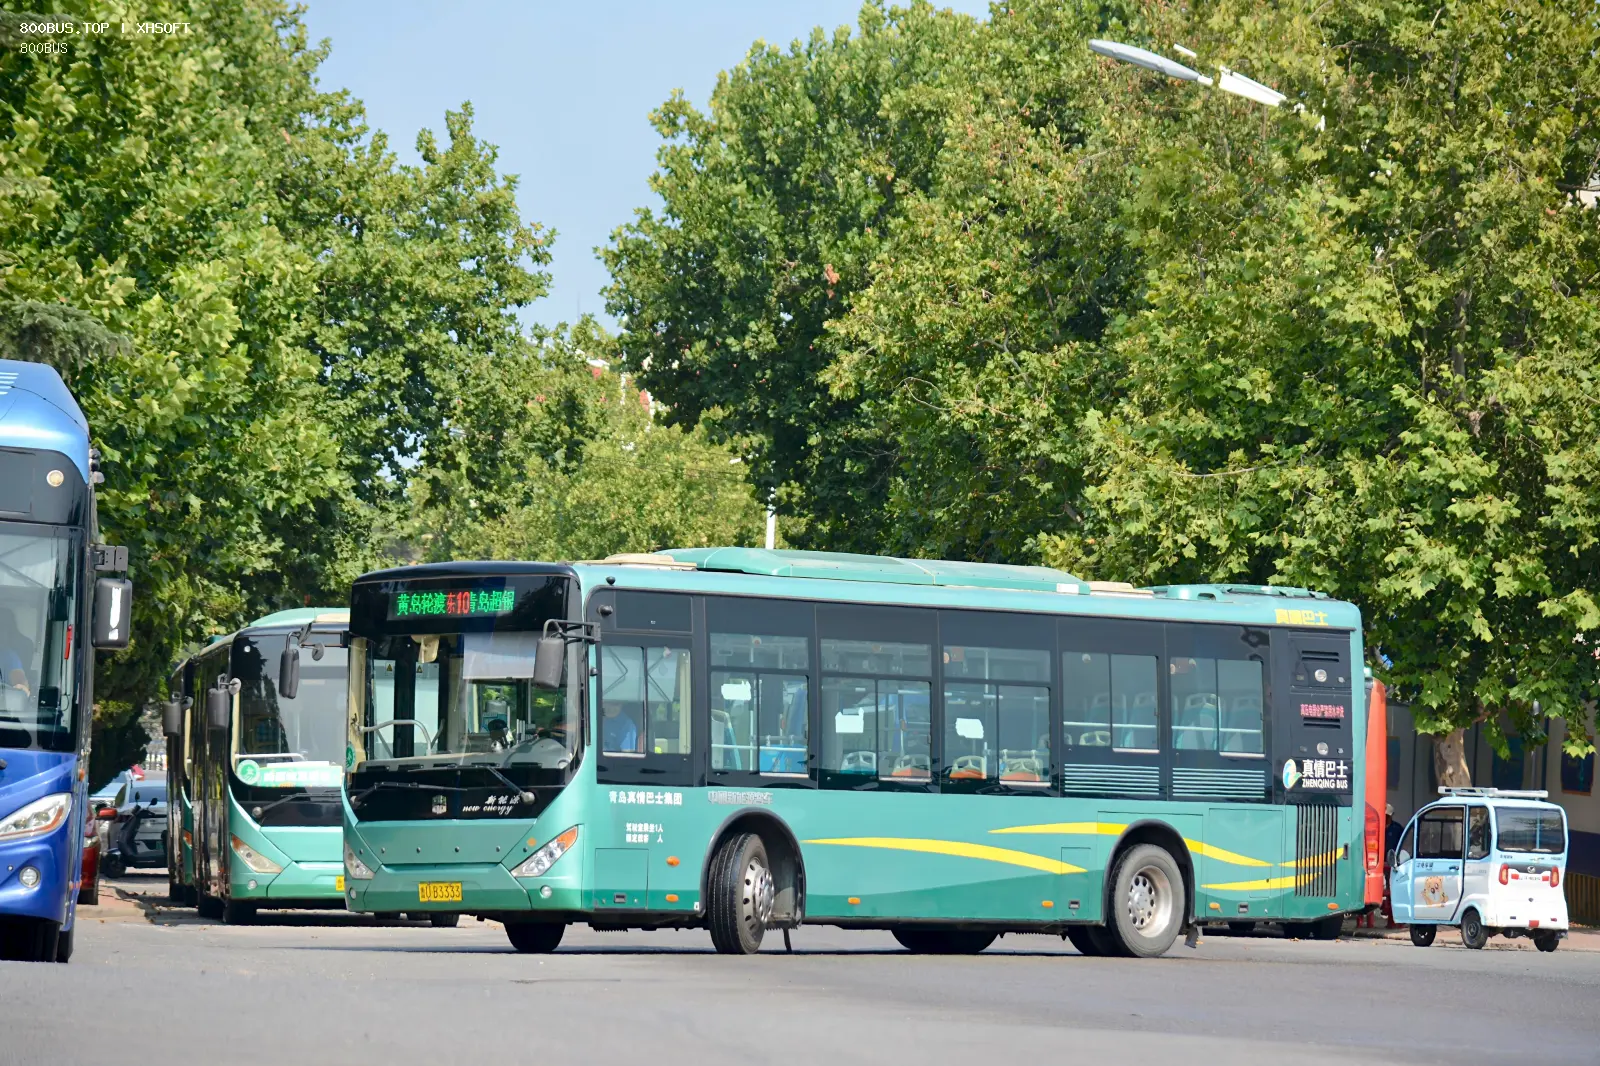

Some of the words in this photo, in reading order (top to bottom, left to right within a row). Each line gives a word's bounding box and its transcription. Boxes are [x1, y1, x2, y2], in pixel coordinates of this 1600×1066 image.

[397, 592, 446, 616] 黄岛轮渡
[1302, 758, 1349, 778] 真情巴士
[1302, 778, 1336, 789] ZHENQING
[1336, 779, 1349, 789] BUS
[485, 795, 520, 805] 新能源
[608, 790, 683, 806] 青岛真情巴士集团
[483, 805, 514, 816] energy
